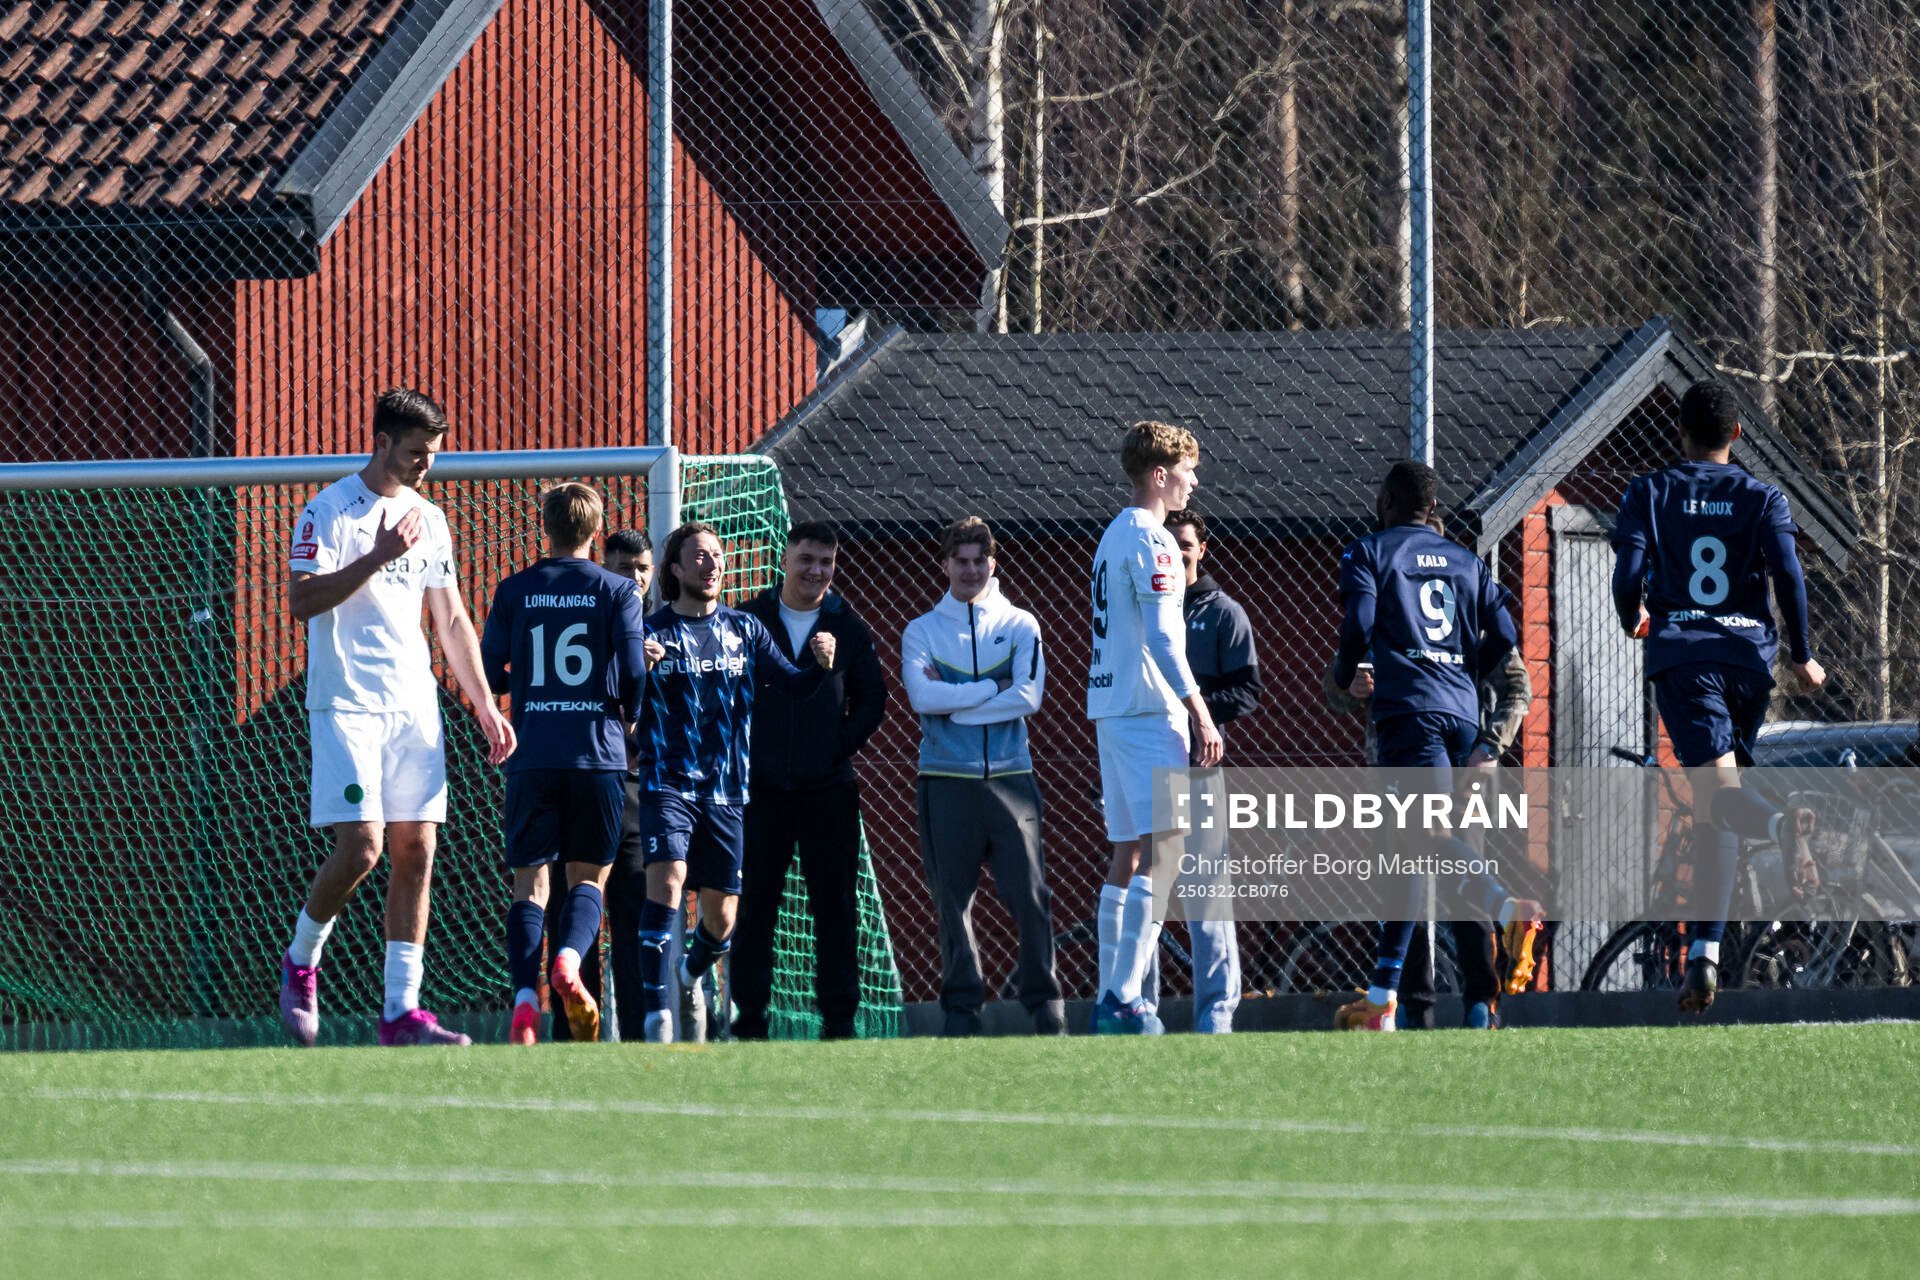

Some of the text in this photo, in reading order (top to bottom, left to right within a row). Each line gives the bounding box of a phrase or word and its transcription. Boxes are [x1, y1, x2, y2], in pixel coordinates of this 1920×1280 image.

[1683, 499, 1734, 516] LE ROUX
[1416, 554, 1448, 568] KALU
[1688, 536, 1730, 606] 8
[525, 594, 597, 608] LOHIKANGAS
[1420, 579, 1456, 642] 9
[529, 622, 593, 687] 16
[649, 836, 658, 853] 3
